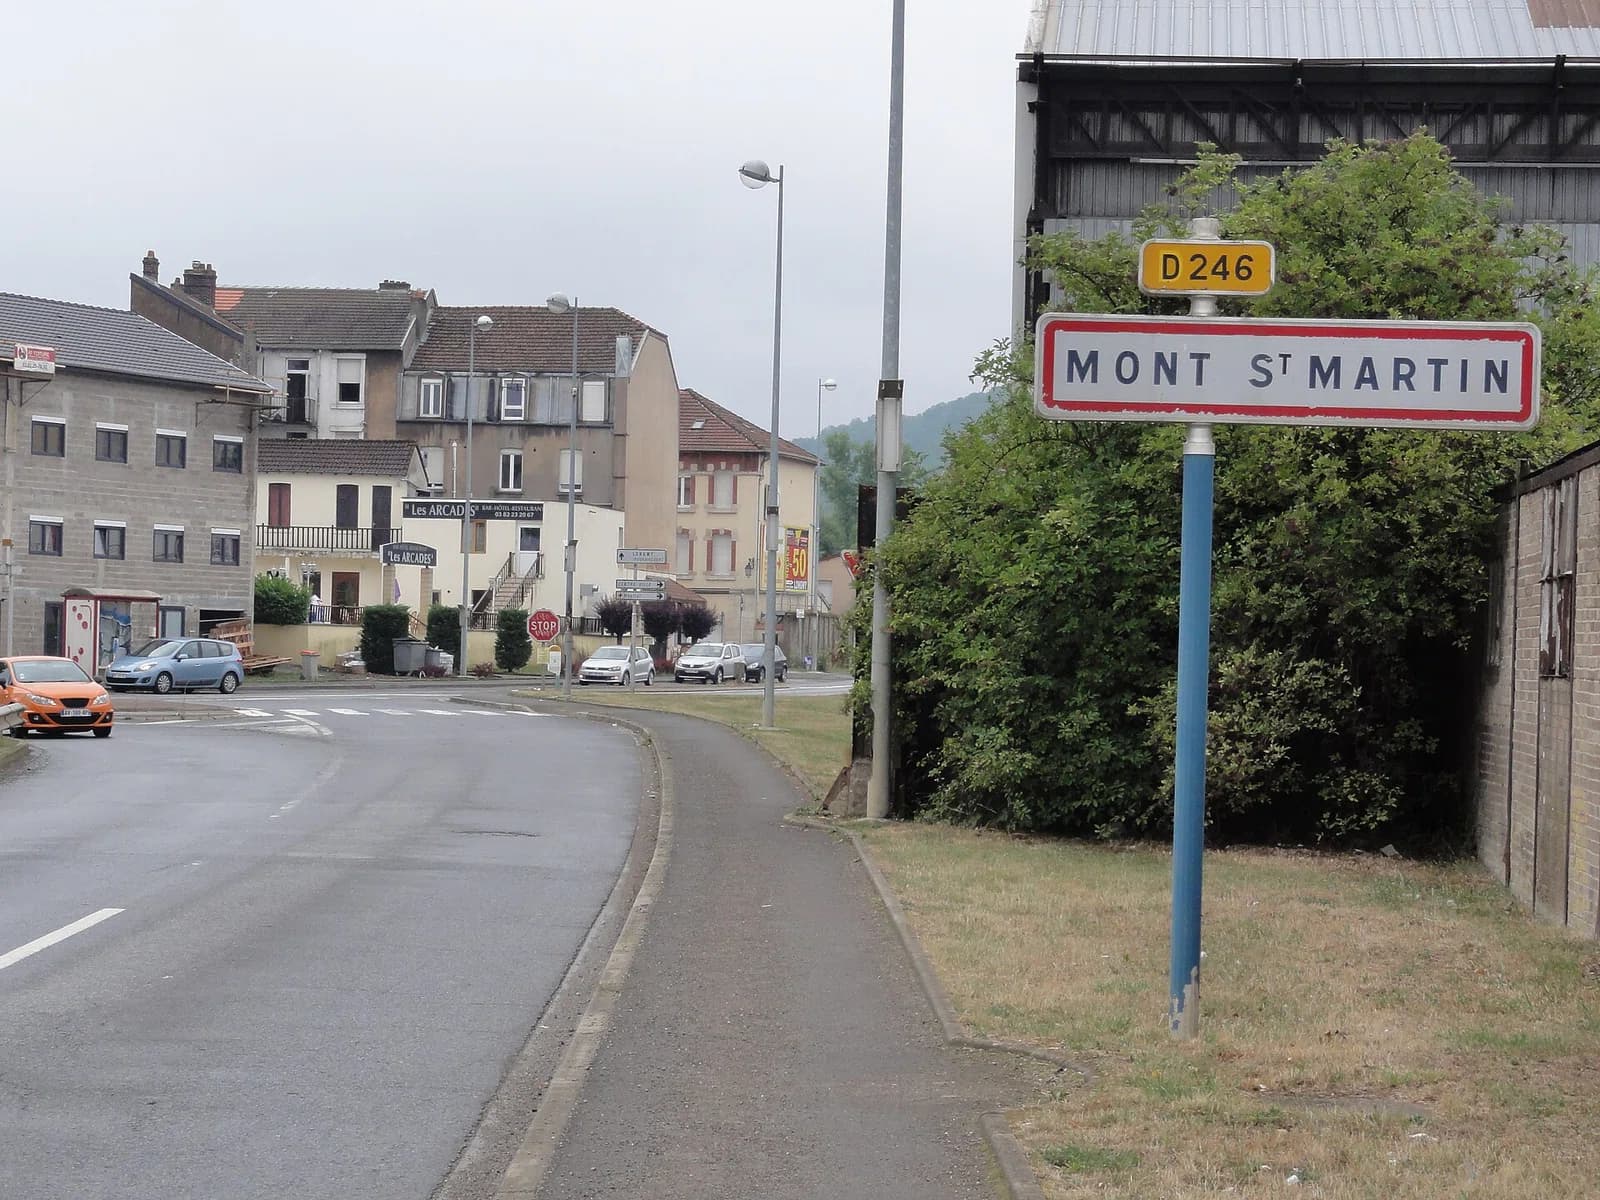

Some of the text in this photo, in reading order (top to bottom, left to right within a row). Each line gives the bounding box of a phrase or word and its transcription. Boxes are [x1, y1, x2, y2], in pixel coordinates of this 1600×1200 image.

[1162, 253, 1254, 281] D 246
[1066, 350, 1211, 386] MONT
[1308, 355, 1509, 394] MARTIN
[429, 504, 479, 517] ARCADS"
[793, 548, 807, 578] 50
[531, 621, 557, 631] STOP
